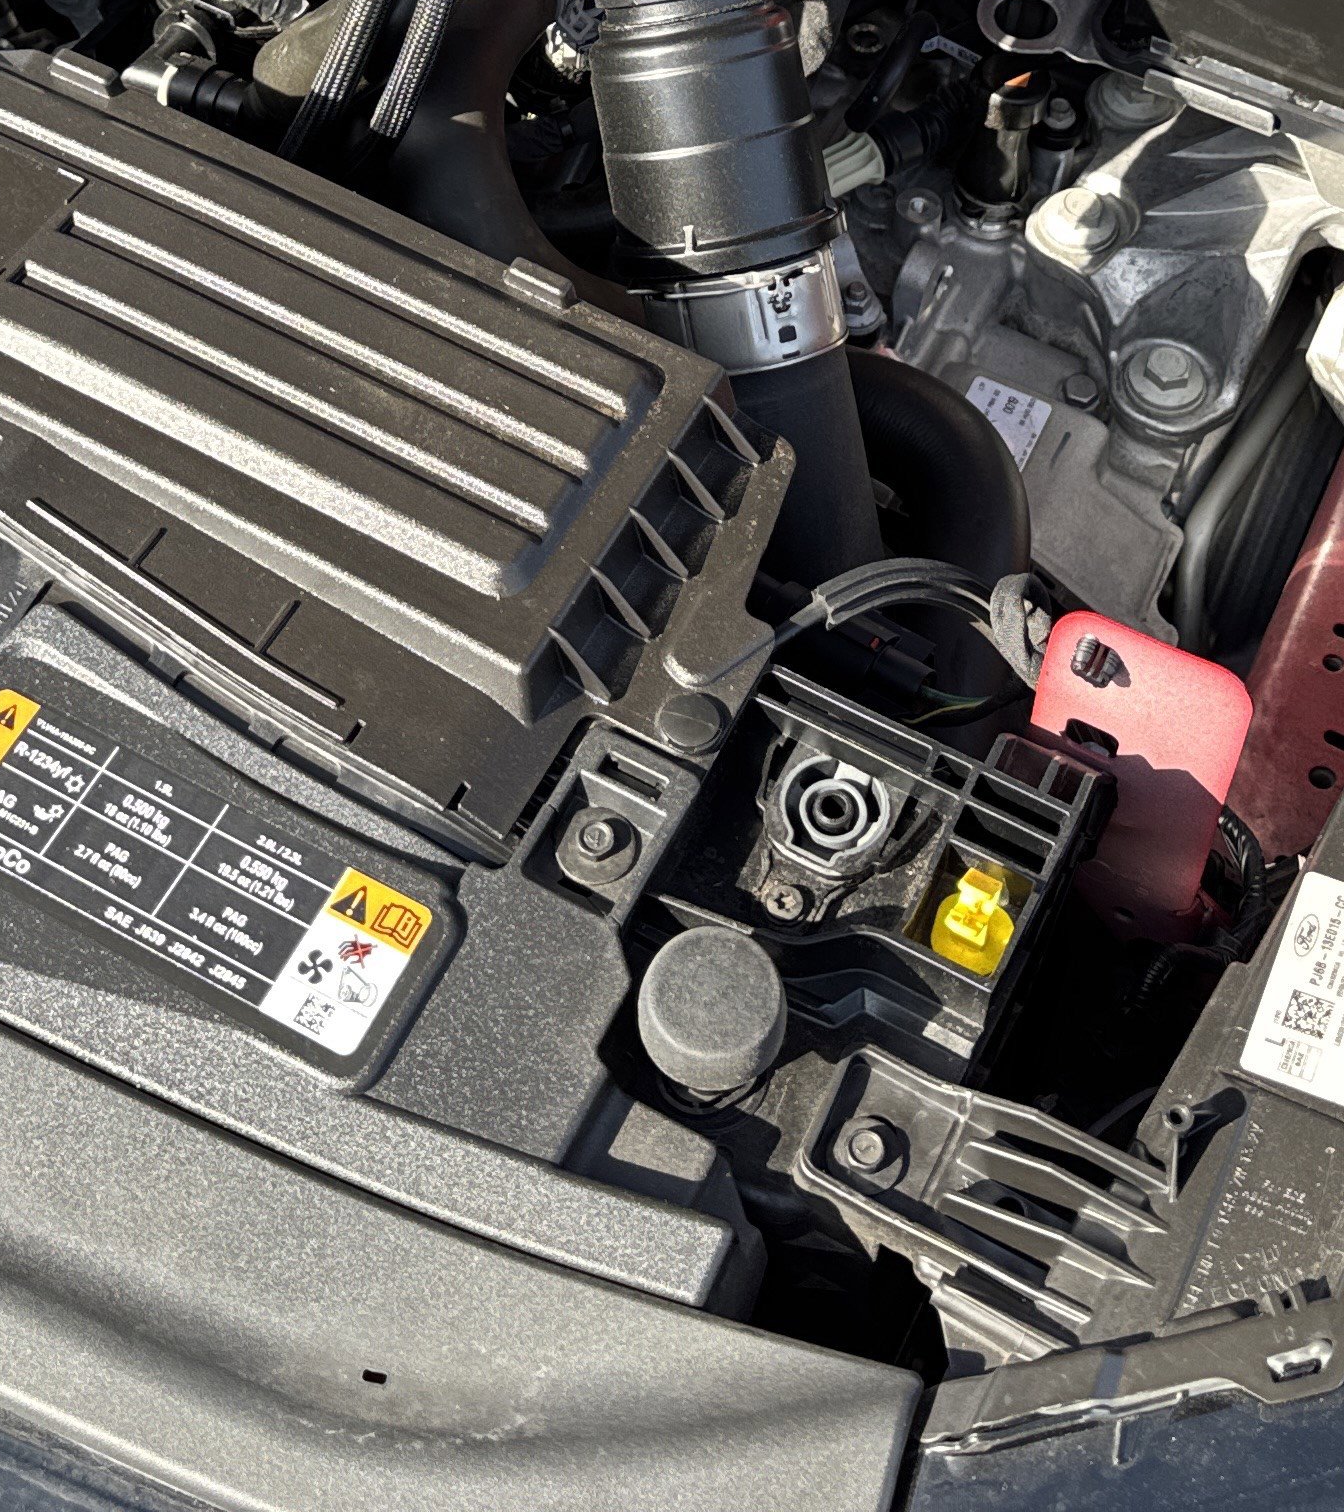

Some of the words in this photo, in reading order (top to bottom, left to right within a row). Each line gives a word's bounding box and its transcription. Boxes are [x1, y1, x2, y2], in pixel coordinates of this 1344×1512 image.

[9, 739, 74, 784] R-1234yf
[120, 793, 154, 820] 0.500
[149, 810, 171, 831] kg
[72, 843, 92, 861] 2.7
[102, 841, 130, 864] PAG
[265, 869, 290, 892] kg
[101, 904, 133, 929] SAE
[132, 920, 167, 947] J639
[186, 906, 208, 926] 3.4
[219, 905, 248, 929] PAG
[1293, 919, 1319, 952] Ford
